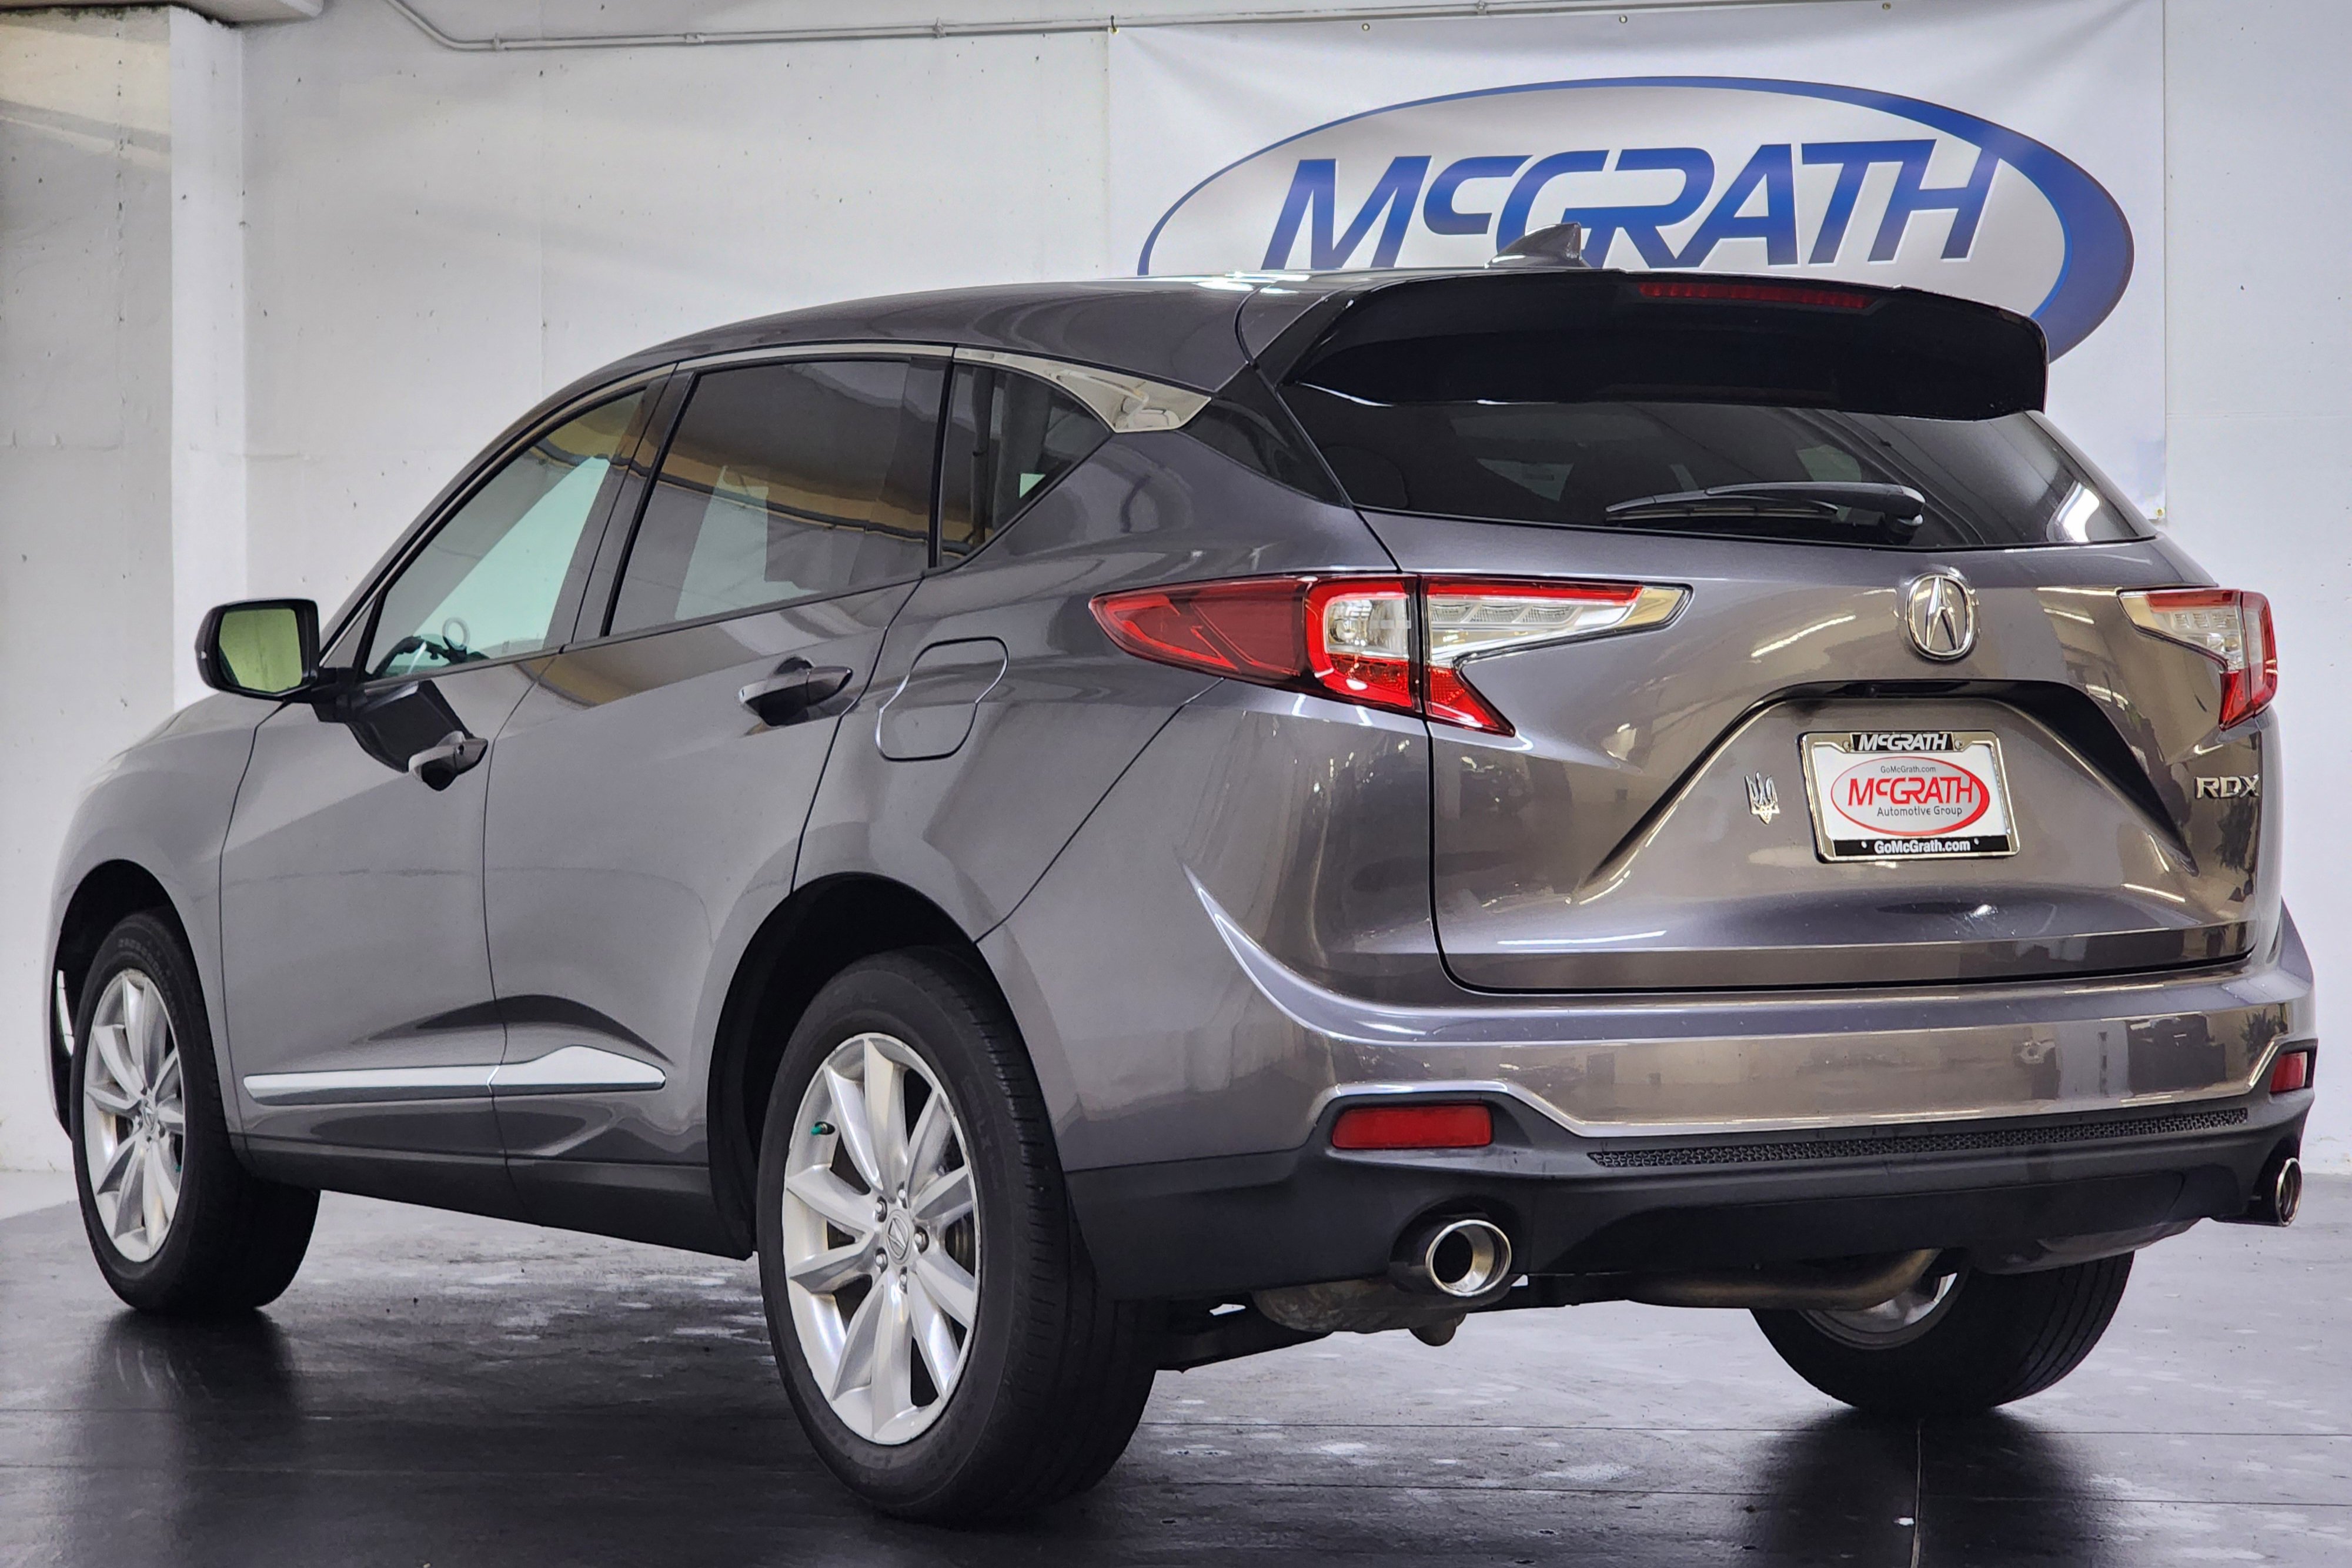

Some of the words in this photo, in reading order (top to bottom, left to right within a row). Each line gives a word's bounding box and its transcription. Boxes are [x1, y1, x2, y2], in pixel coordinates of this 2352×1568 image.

[1880, 765, 1936, 774] GoMcGrath.com
[2194, 773, 2260, 798] RDX
[1876, 805, 1931, 817] Automotive
[1933, 805, 1963, 817] Group
[1874, 839, 1970, 854] GoMcGrath.com
